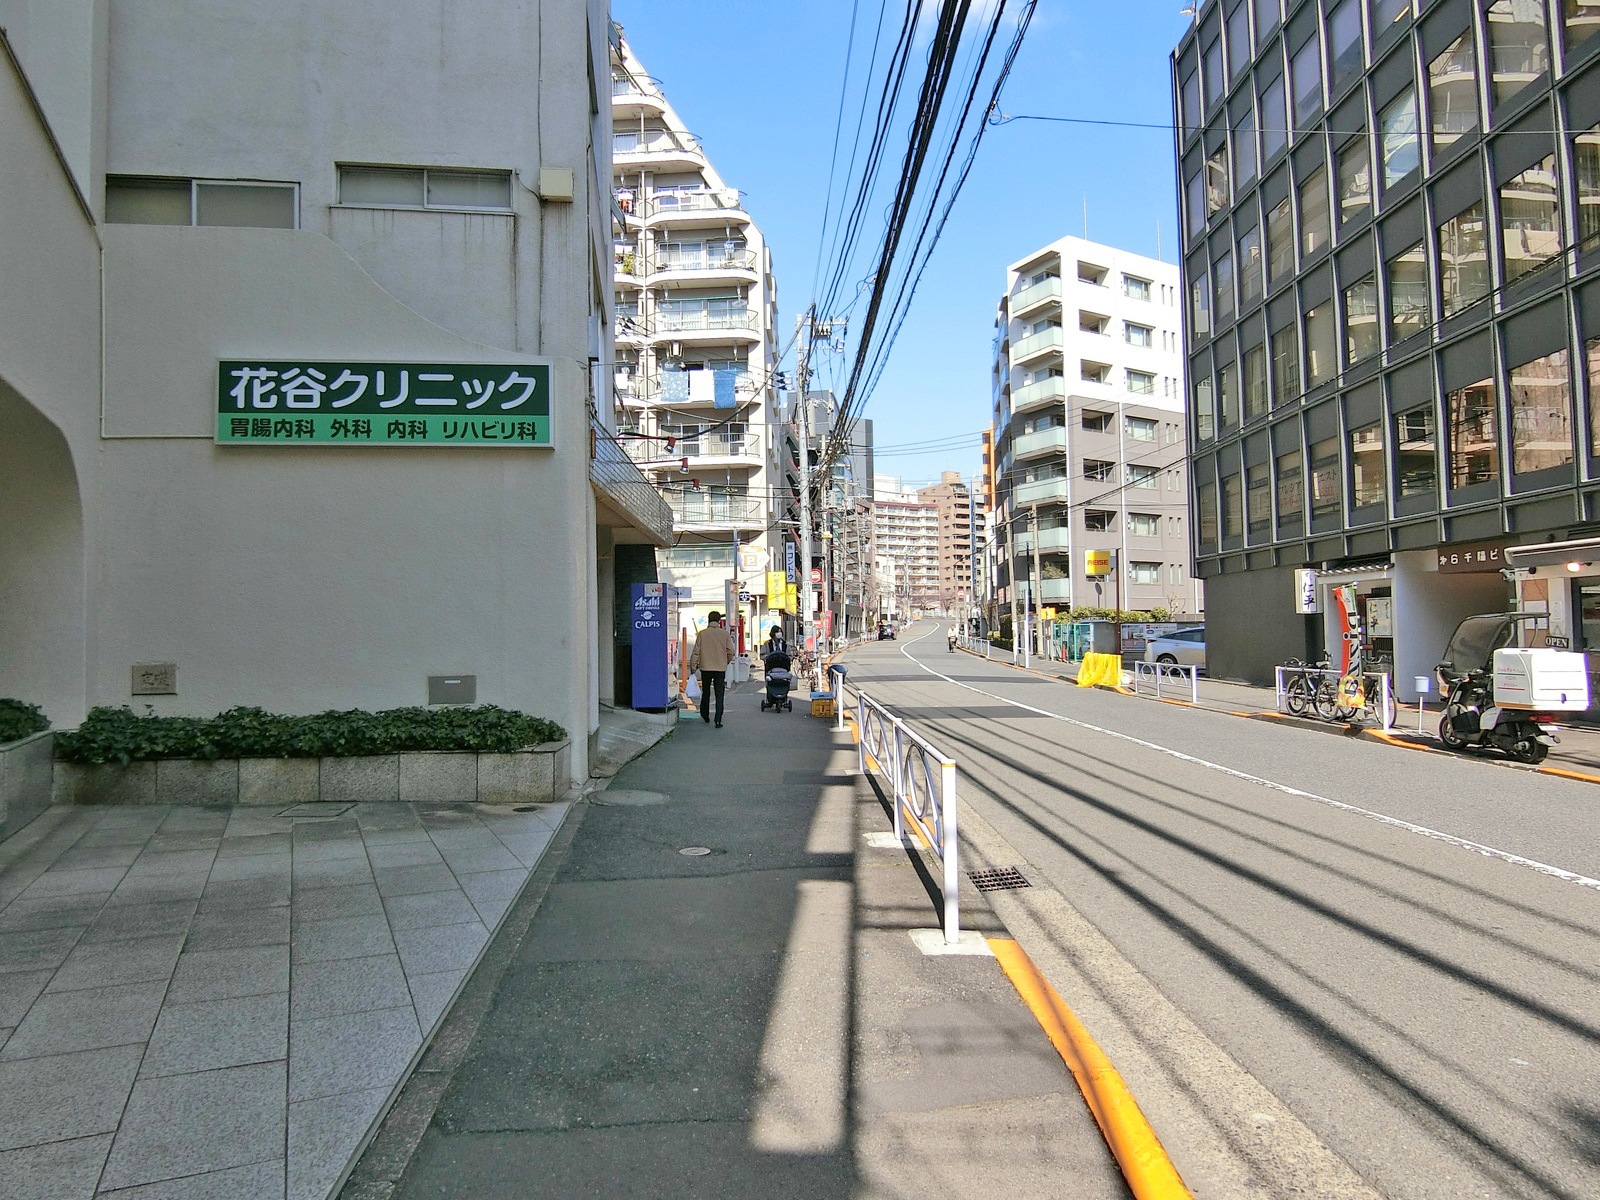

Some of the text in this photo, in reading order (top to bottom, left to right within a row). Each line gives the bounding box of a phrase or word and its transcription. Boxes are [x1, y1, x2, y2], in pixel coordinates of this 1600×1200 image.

[230, 367, 536, 410] 花谷クリニック
[230, 417, 537, 441] 胃腸内科 外科 内科 リハビリ科
[634, 596, 660, 607] Asahi
[634, 620, 661, 629] CALPIS
[1545, 636, 1568, 647] OPEN
